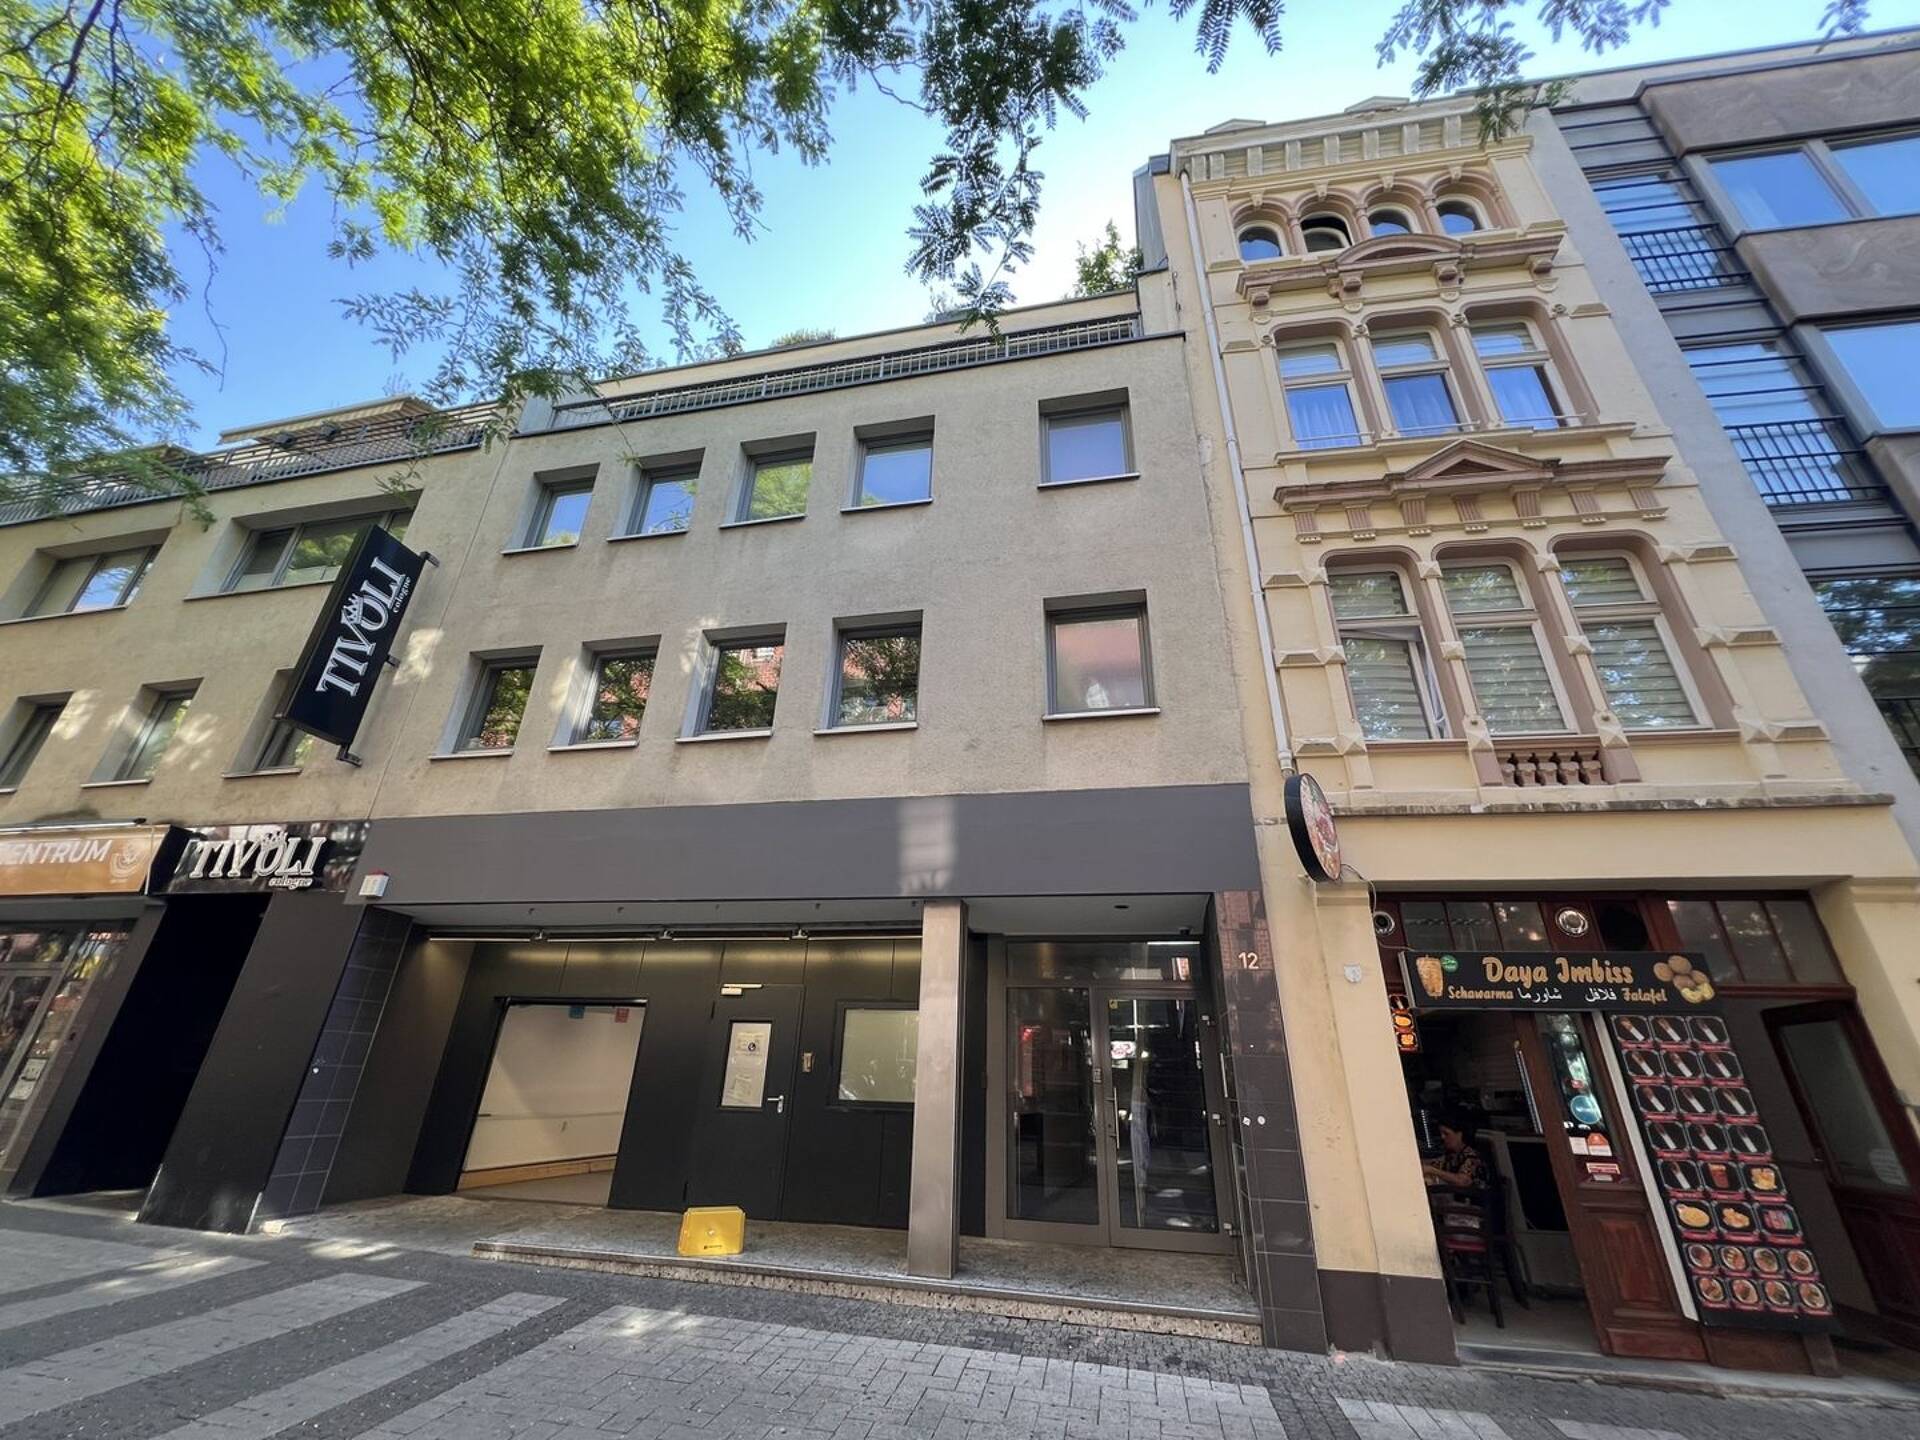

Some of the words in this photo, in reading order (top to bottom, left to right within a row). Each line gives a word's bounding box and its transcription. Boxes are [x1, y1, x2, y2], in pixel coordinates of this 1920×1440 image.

[392, 576, 412, 613] cologne
[315, 556, 406, 697] TIVOLI
[189, 835, 327, 878] TIVOLI
[1238, 951, 1259, 969] 12
[1482, 956, 1549, 989] Daya
[1555, 956, 1634, 984] Imbiss
[1449, 985, 1514, 1000] Schawarma
[1516, 987, 1562, 1003] شاورما
[1584, 987, 1617, 1003] فلافل
[1621, 987, 1668, 1005] Falafel
